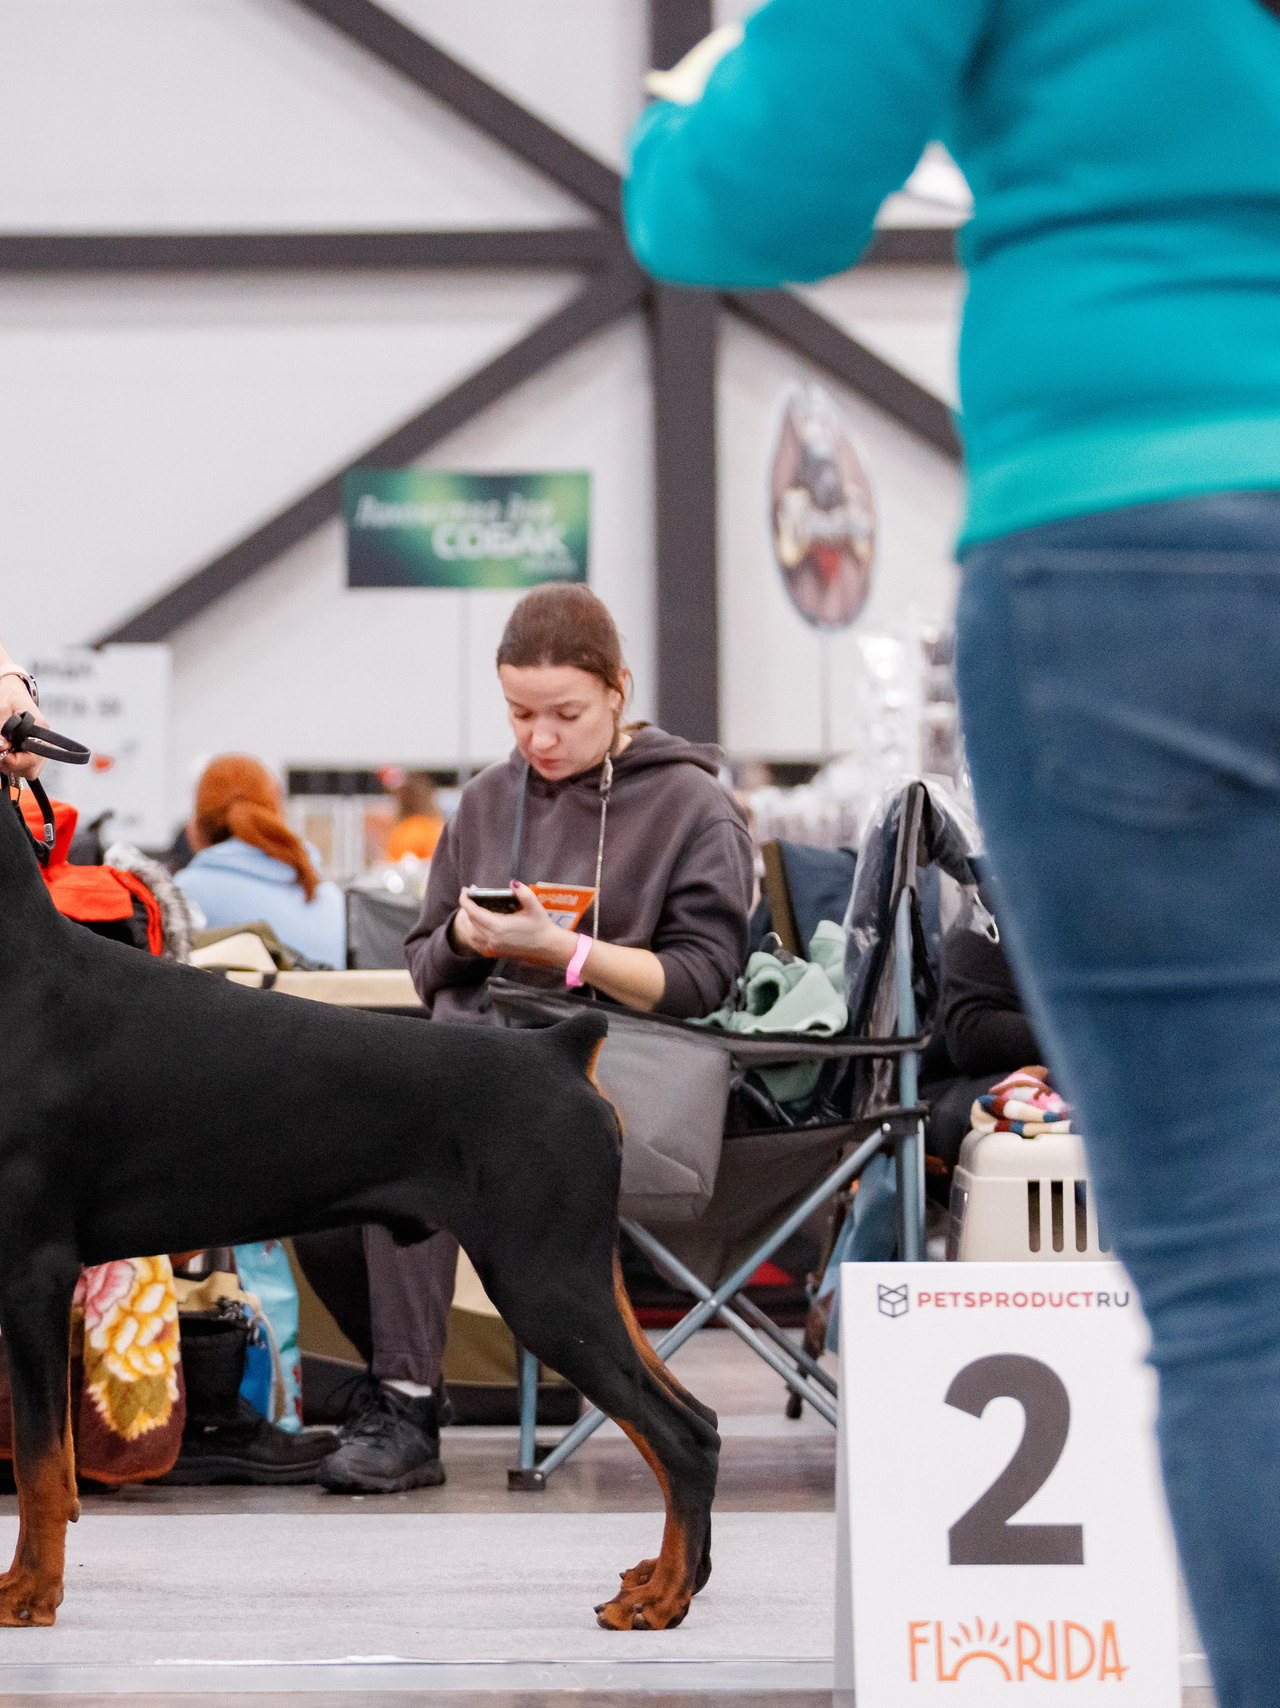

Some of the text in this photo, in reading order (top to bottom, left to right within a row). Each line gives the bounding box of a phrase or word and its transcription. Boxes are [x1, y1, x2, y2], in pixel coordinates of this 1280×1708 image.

[917, 1290, 1130, 1310] PETSPRODUCTRU
[943, 1351, 1085, 1566] 2
[907, 1615, 1130, 1683] FLORIDA
